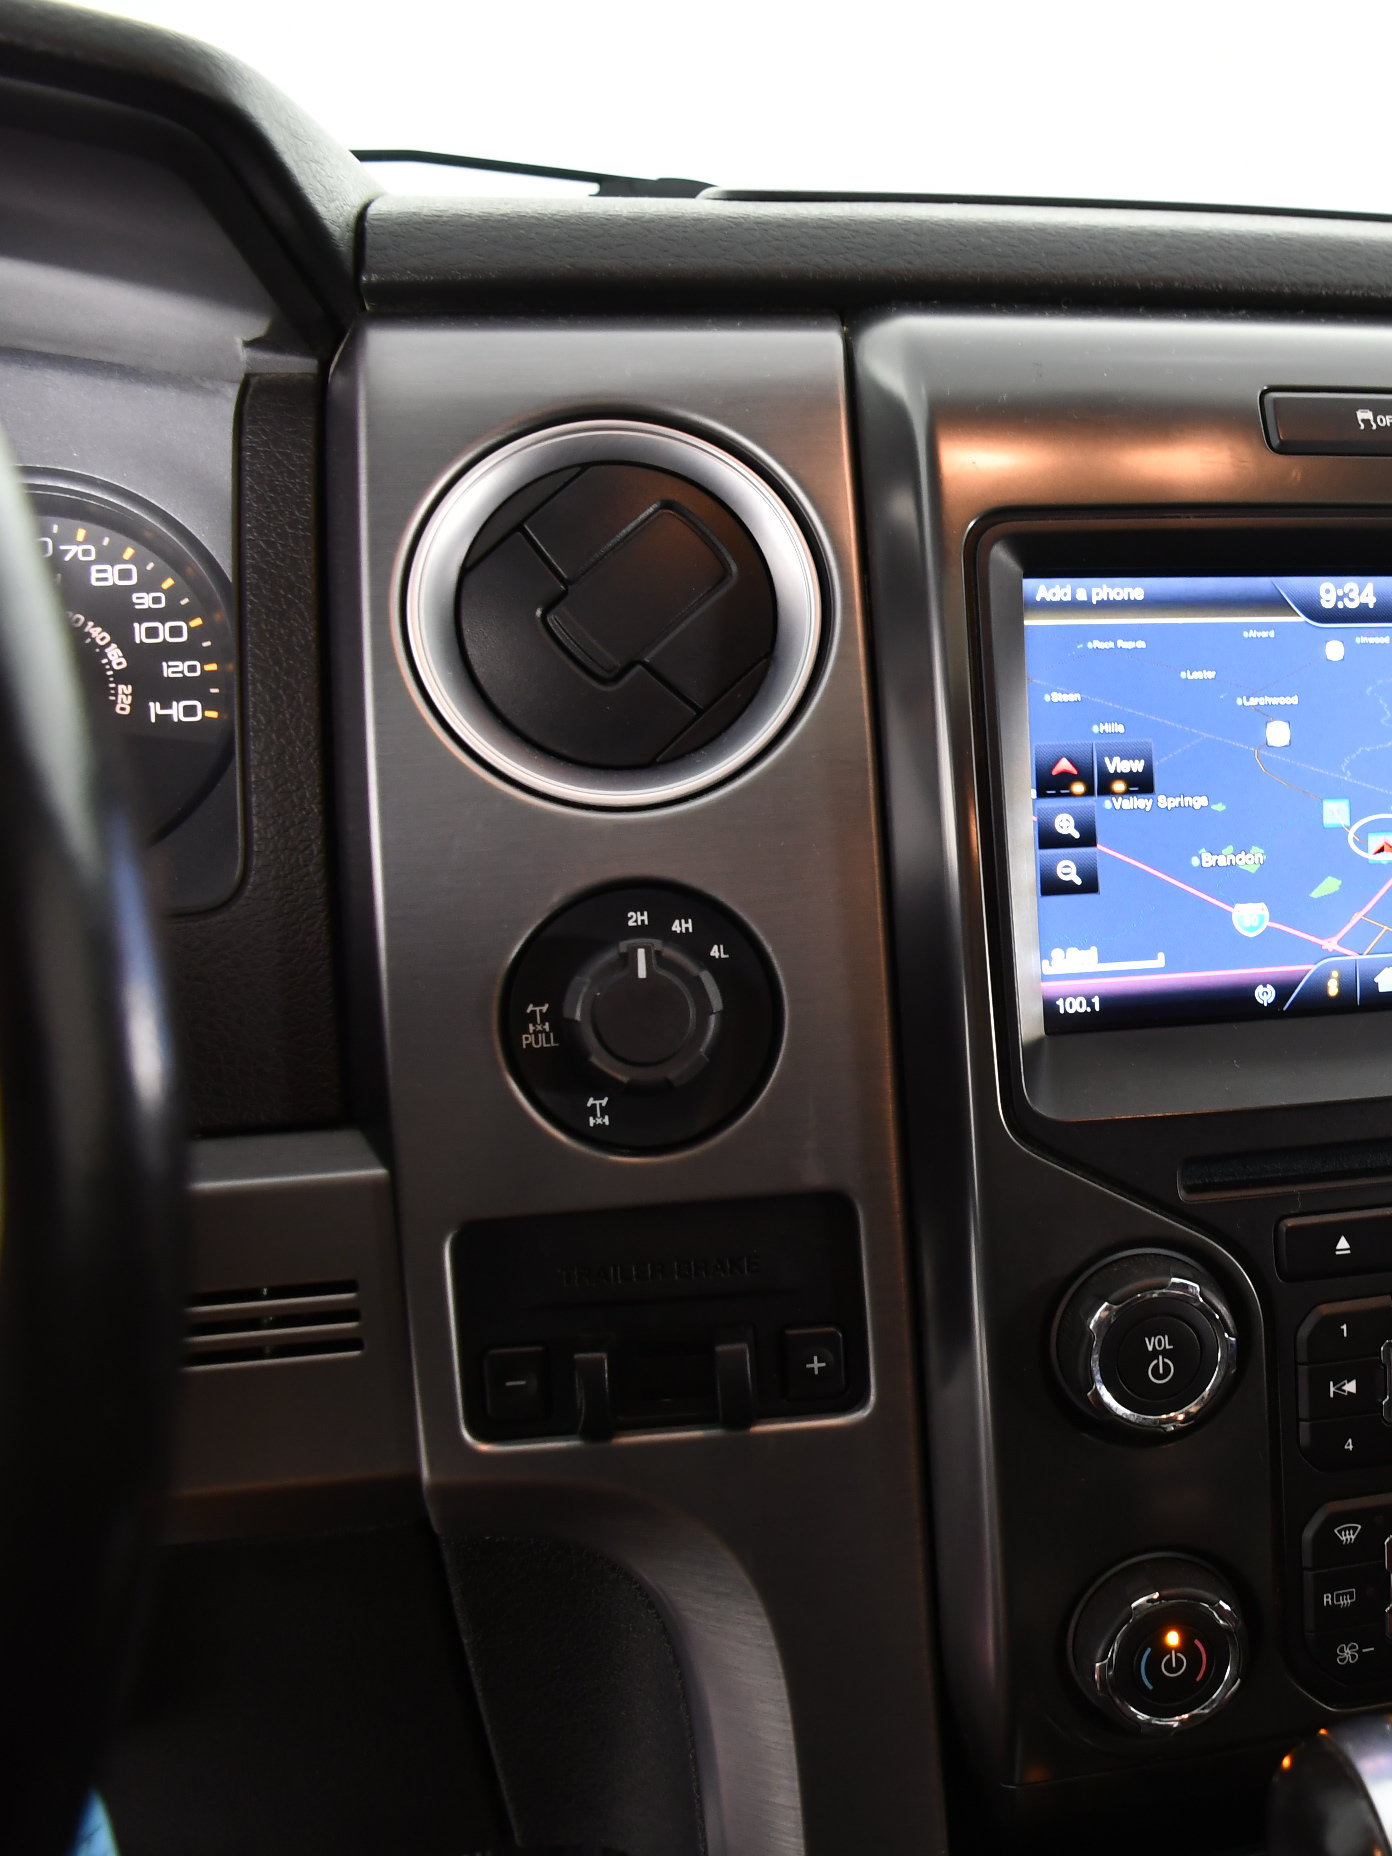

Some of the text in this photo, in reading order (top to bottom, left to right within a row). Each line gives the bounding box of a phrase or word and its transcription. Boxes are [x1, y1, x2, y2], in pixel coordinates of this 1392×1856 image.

[59, 544, 97, 562] 70
[90, 563, 138, 586] 80
[131, 592, 166, 609] 90
[1035, 583, 1145, 604] Add a phone
[1319, 582, 1377, 609] 9:34
[83, 620, 111, 646] 140
[133, 621, 188, 644] 100
[104, 642, 128, 671] 160
[162, 660, 201, 678] 120
[115, 683, 133, 715] 220
[148, 699, 203, 723] 140
[1103, 756, 1145, 774] View
[1111, 794, 1209, 812] Valley Springs
[1201, 851, 1265, 868] Brandon
[627, 911, 649, 927] 2H
[671, 918, 693, 934] 4H
[709, 944, 730, 959] 4L
[1055, 995, 1100, 1014] 100.1
[521, 1033, 560, 1049] PULL
[558, 1255, 761, 1288] TRAILER BRAKE
[1340, 1323, 1348, 1338] 1
[1144, 1334, 1174, 1352] VOL
[1344, 1437, 1354, 1451] 4
[1323, 1593, 1332, 1606] R
